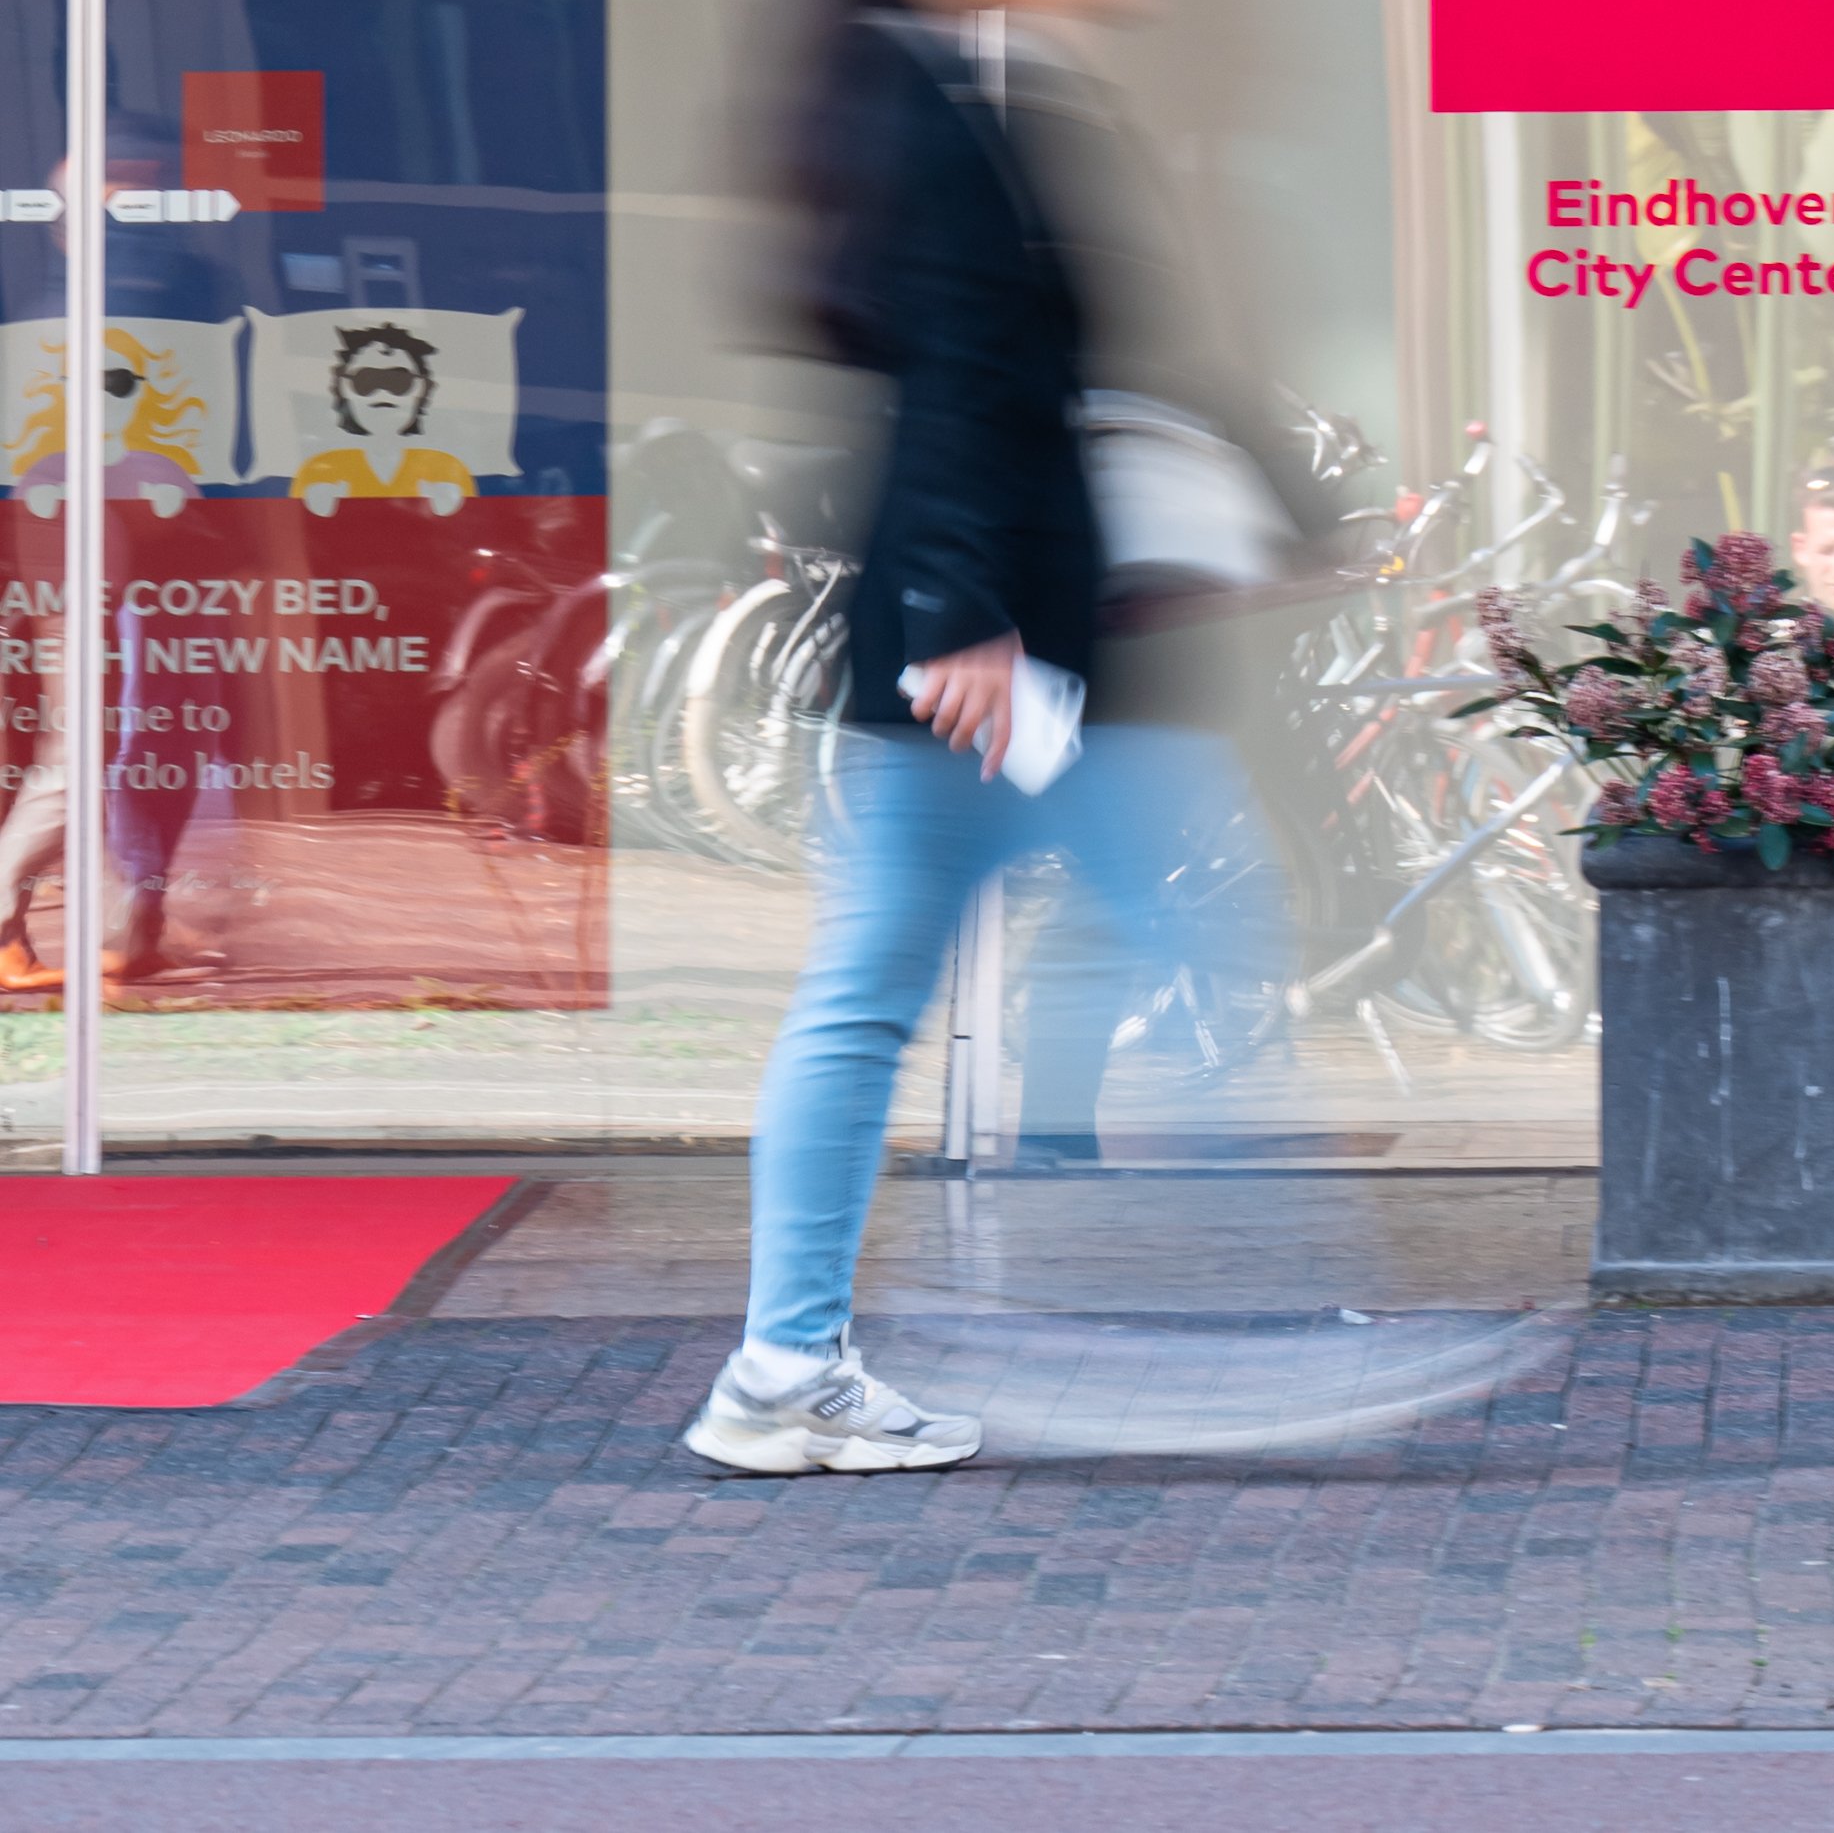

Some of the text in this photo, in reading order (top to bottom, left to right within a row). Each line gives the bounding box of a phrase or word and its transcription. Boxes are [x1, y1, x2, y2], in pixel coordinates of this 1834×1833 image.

[1526, 248, 1656, 309] City
[123, 579, 264, 617] COZY
[273, 578, 390, 621] BED,
[0, 636, 430, 674] REH NEW NAME
[0, 694, 232, 733] elcme to
[194, 750, 335, 790] hotels
